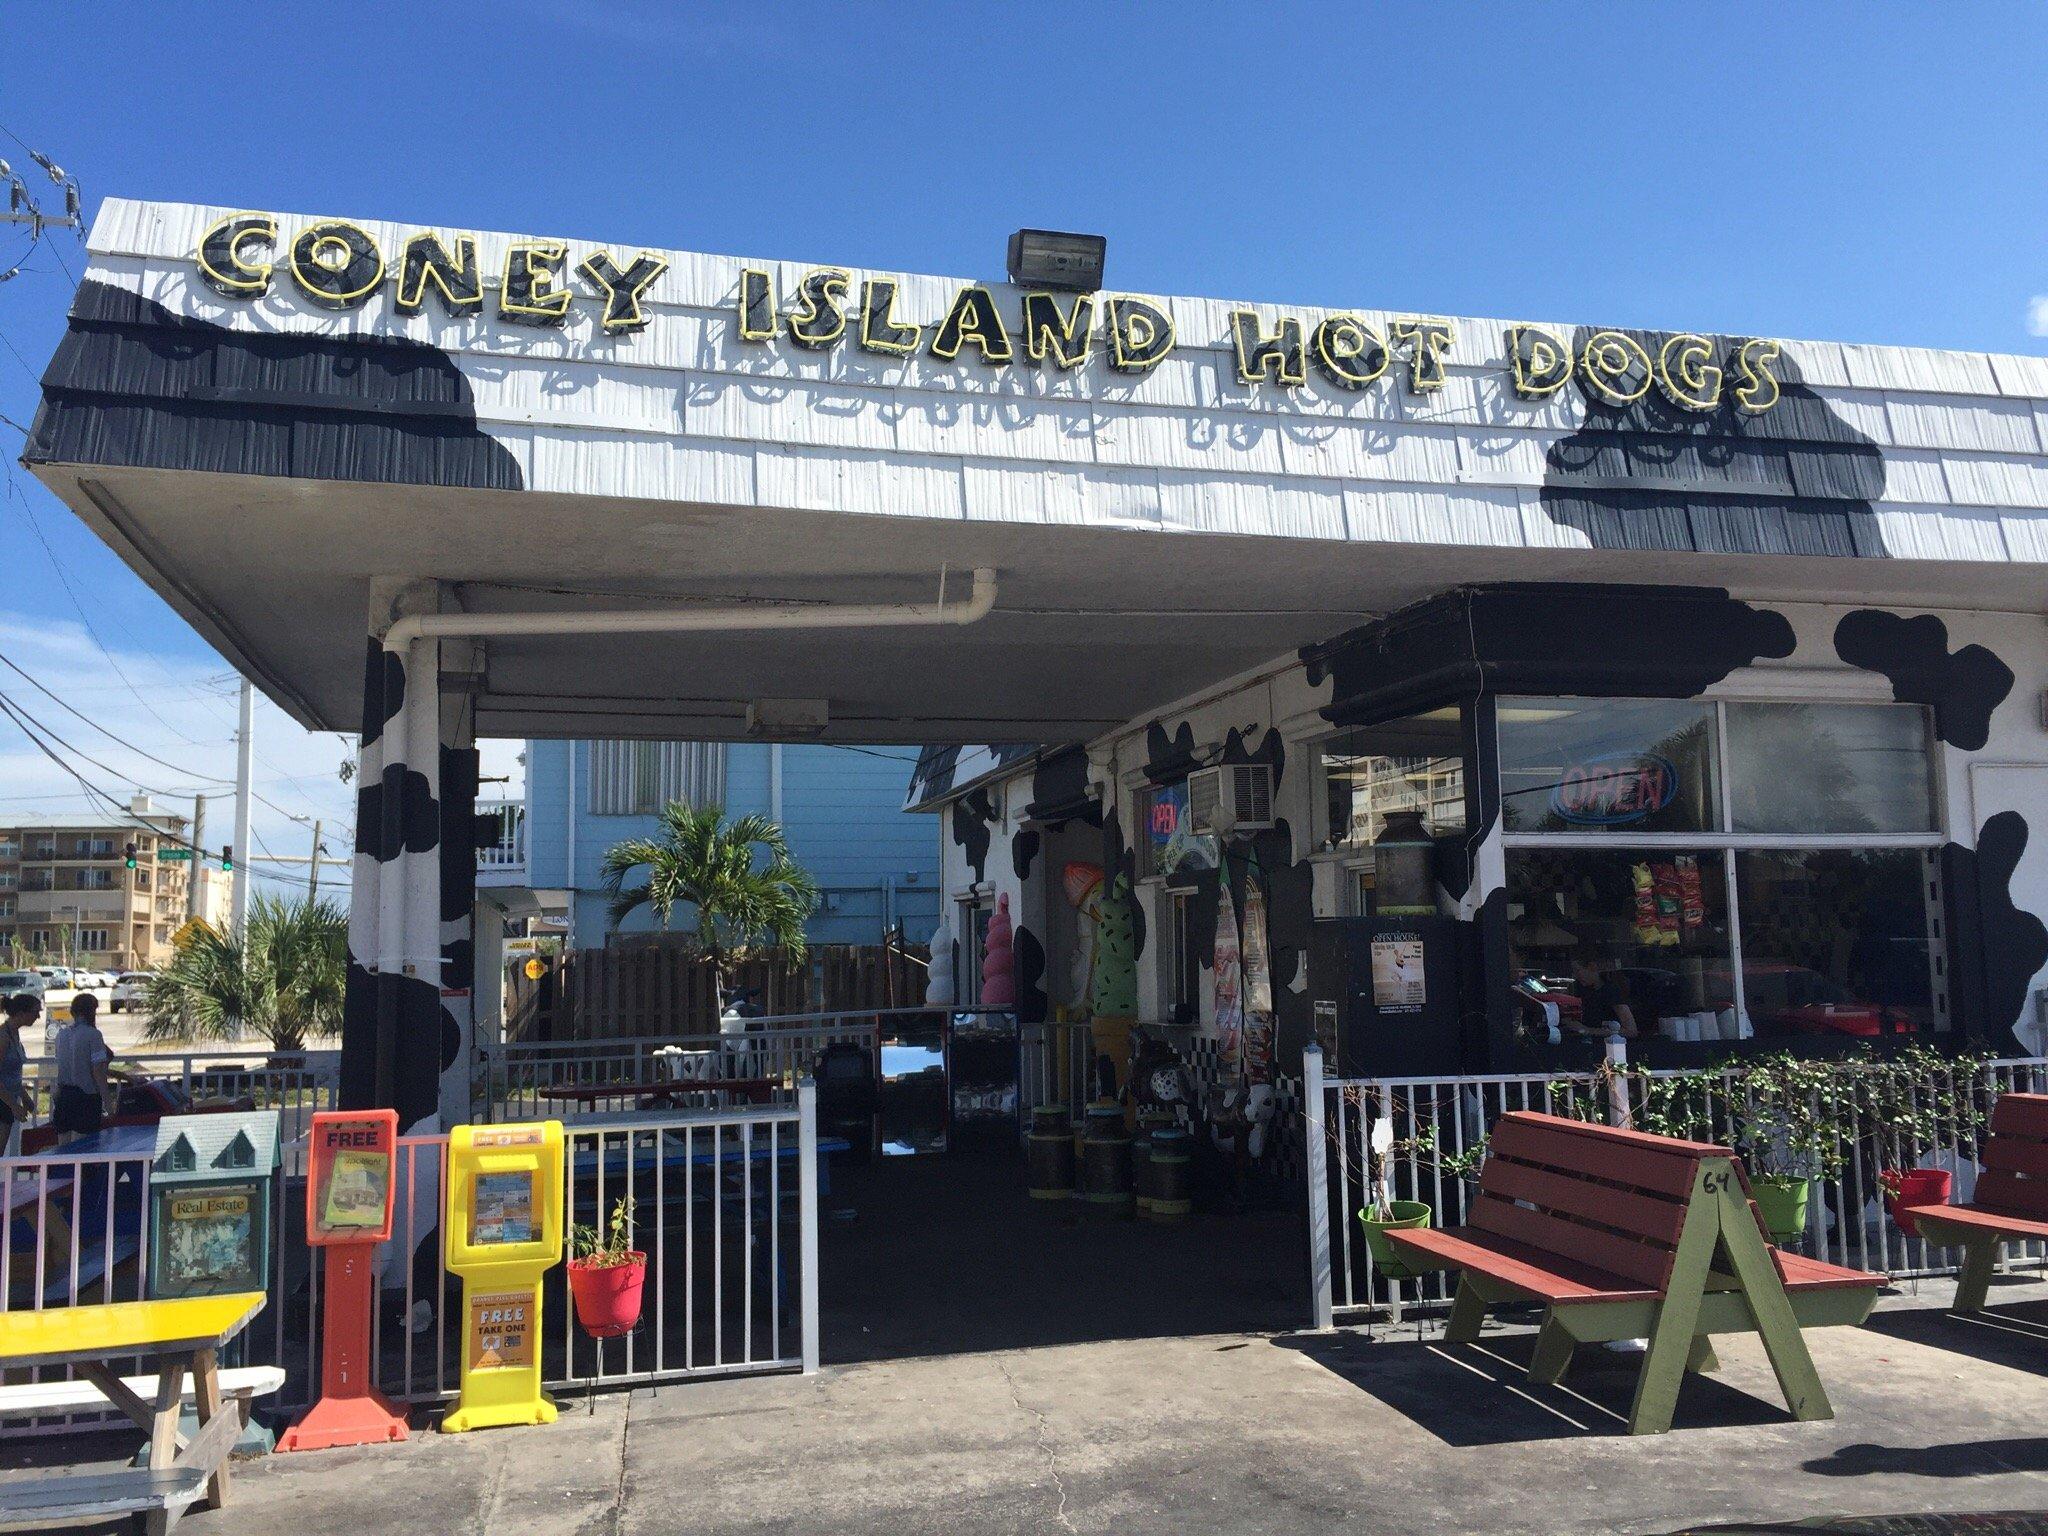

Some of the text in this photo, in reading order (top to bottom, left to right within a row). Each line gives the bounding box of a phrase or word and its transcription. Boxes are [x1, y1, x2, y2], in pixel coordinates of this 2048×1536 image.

[196, 210, 1780, 411] CONEY ISLAND HOT DOGS
[1562, 765, 1664, 812] OPEN
[1151, 803, 1178, 834] OPEN
[326, 1131, 379, 1148] FREE
[1703, 1171, 1730, 1194] 64
[176, 1200, 245, 1214] Real Estate
[480, 1307, 524, 1324] FREE
[478, 1324, 527, 1335] TAKE ONE
